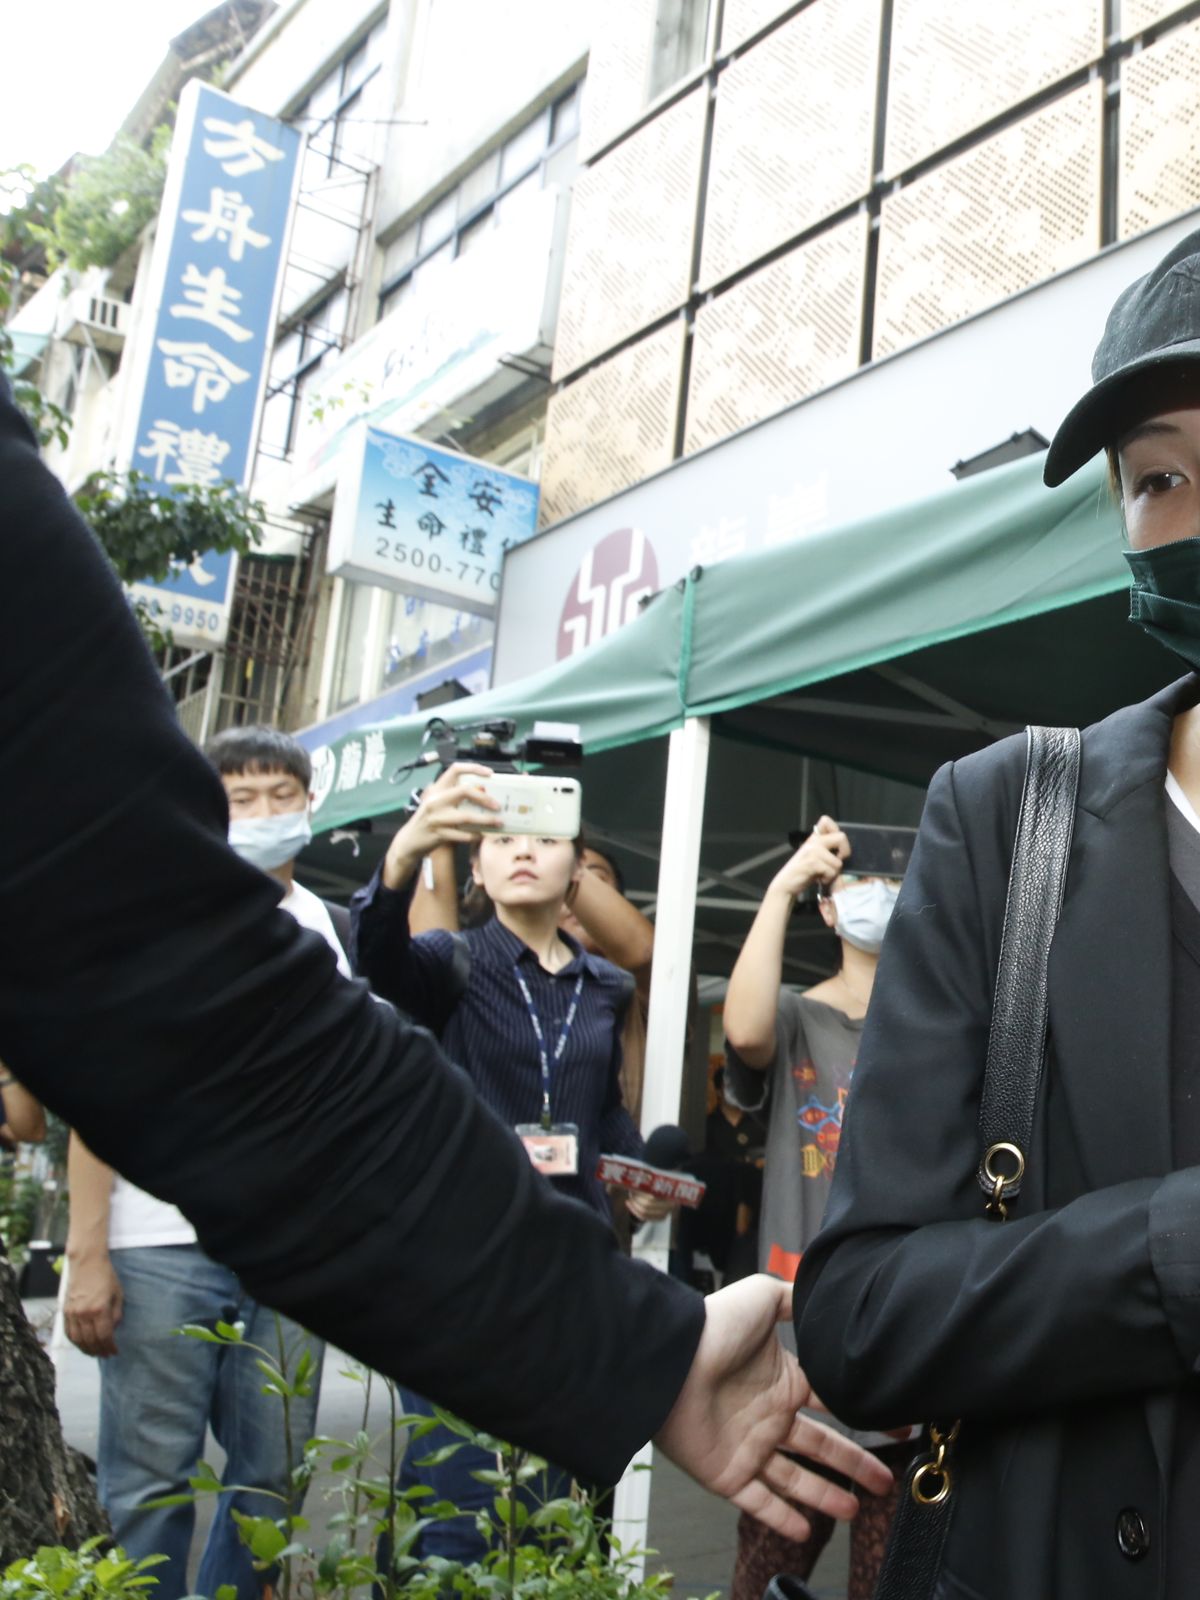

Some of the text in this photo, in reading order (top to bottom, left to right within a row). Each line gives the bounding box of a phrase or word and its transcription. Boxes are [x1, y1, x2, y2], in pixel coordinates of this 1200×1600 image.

[137, 116, 286, 586] 方丹生命禮
